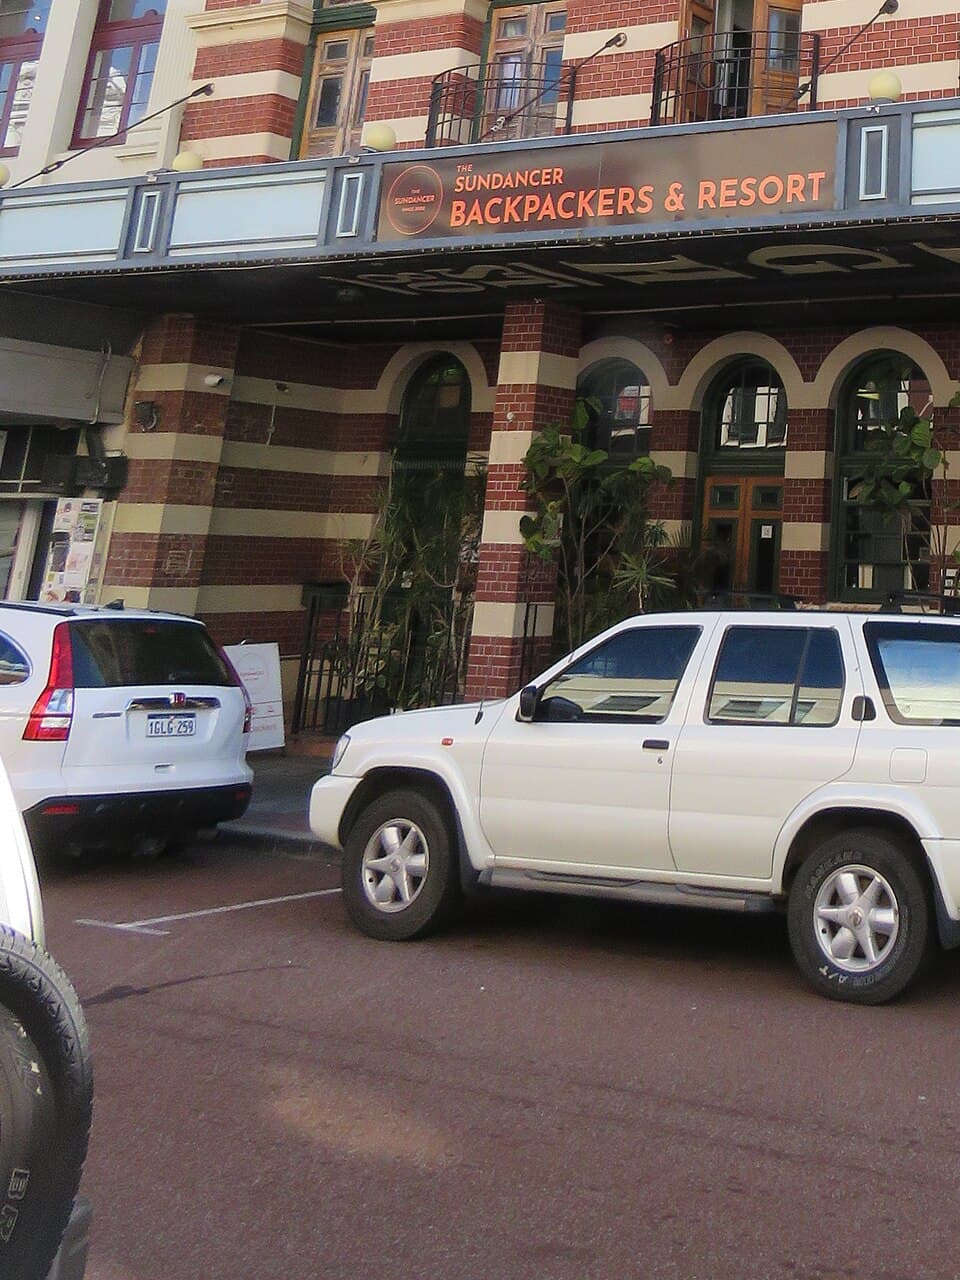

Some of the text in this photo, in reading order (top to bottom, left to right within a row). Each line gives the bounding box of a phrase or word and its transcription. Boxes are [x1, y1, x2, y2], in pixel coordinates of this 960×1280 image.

[457, 164, 473, 172] THE
[455, 168, 563, 192] SUNDANCER
[394, 194, 435, 205] SUNDANCER
[450, 171, 826, 227] BACKPACKERS & RESORT
